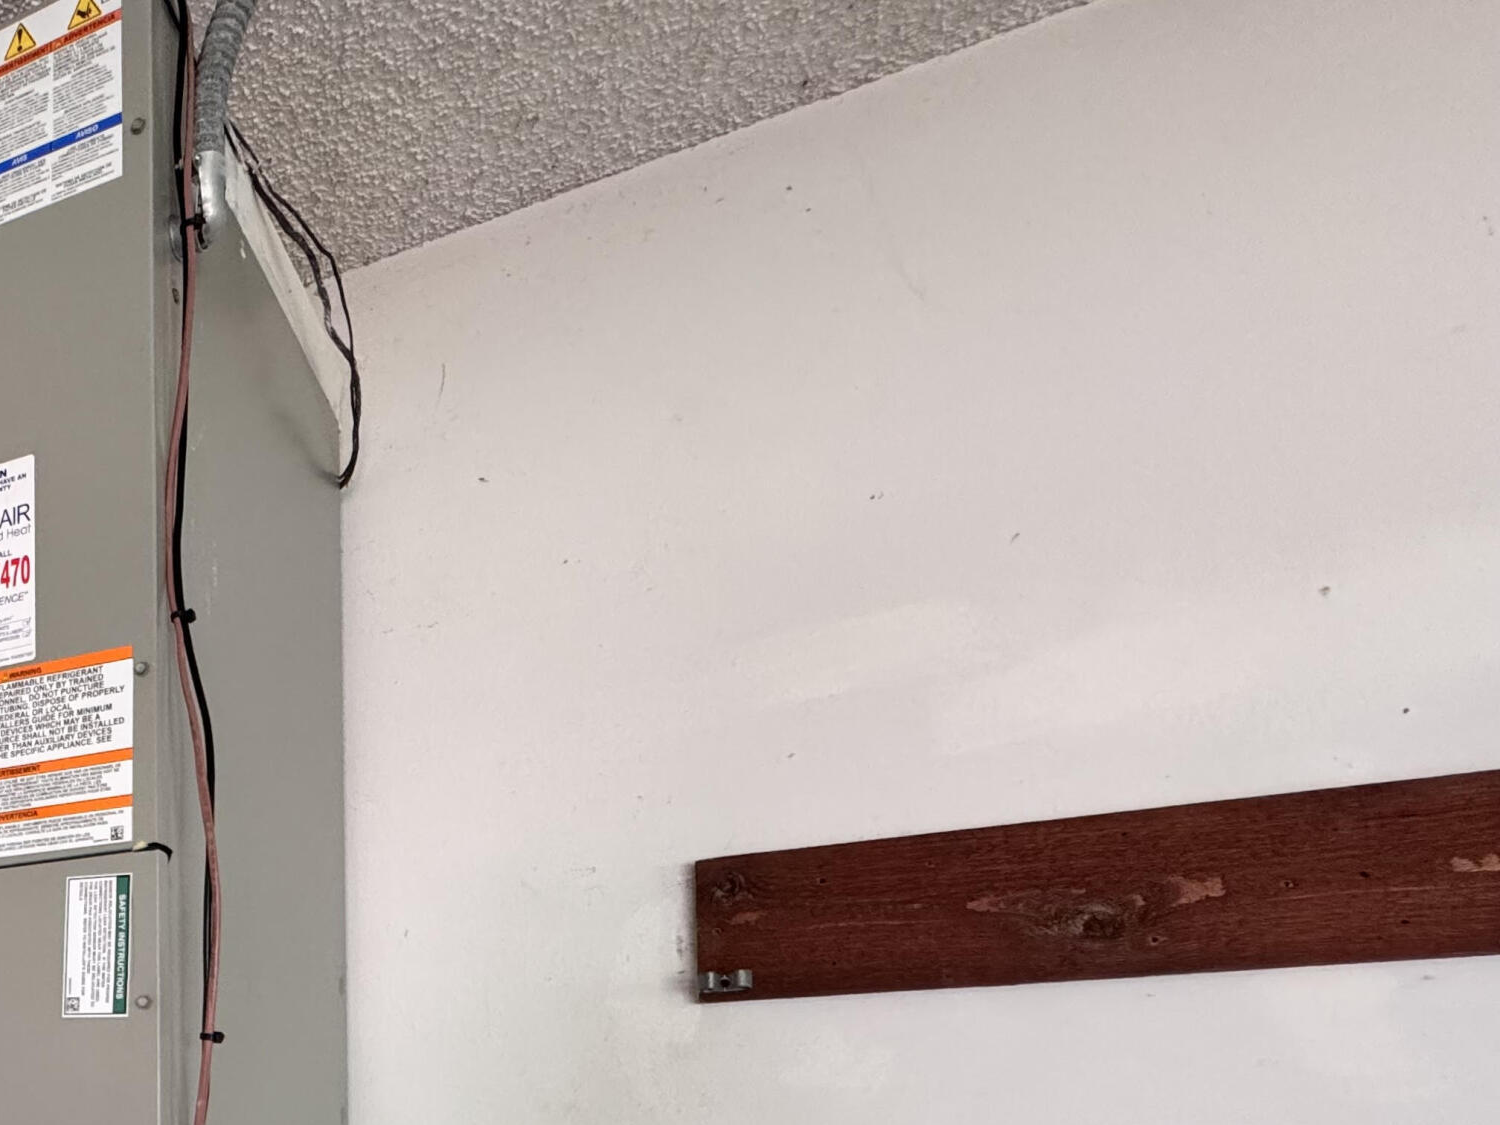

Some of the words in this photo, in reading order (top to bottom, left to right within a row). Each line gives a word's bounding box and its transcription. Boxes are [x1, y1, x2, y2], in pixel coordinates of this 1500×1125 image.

[0, 502, 30, 529] AIR
[6, 522, 31, 539] Heat
[9, 666, 41, 679] WARNING
[33, 683, 53, 693] ONLY
[55, 680, 66, 689] BY
[69, 673, 104, 686] TRAINED
[46, 665, 103, 682] REFRIGERANT
[28, 693, 39, 701] DO
[42, 689, 58, 699] NOT
[60, 681, 104, 695] PUNCTURE
[32, 696, 65, 708] DISPOSE
[68, 693, 78, 702] OF
[81, 685, 124, 699] PROPERLY
[31, 708, 43, 716] OR
[45, 703, 71, 714] LOCAL
[31, 713, 55, 724] GUIDE
[58, 710, 74, 719] FOR
[76, 703, 112, 716] MINIMUM
[0, 725, 32, 736] DEVICES
[35, 720, 61, 731] WHICH
[63, 717, 79, 726] MAY
[82, 715, 92, 723] BE
[95, 713, 100, 721] A
[22, 730, 46, 741] SHALL
[49, 727, 64, 736] NOT
[67, 724, 78, 733] BE
[80, 717, 124, 731] INSTALLED
[10, 745, 44, 757] SPECIFIC
[96, 735, 112, 744] SEE
[11, 740, 33, 750] THAN
[34, 733, 75, 746] AUXILIARY
[77, 727, 112, 739] DEVICES
[117, 893, 126, 929] SAFETY
[116, 931, 125, 999] INSTRUCTIONS
